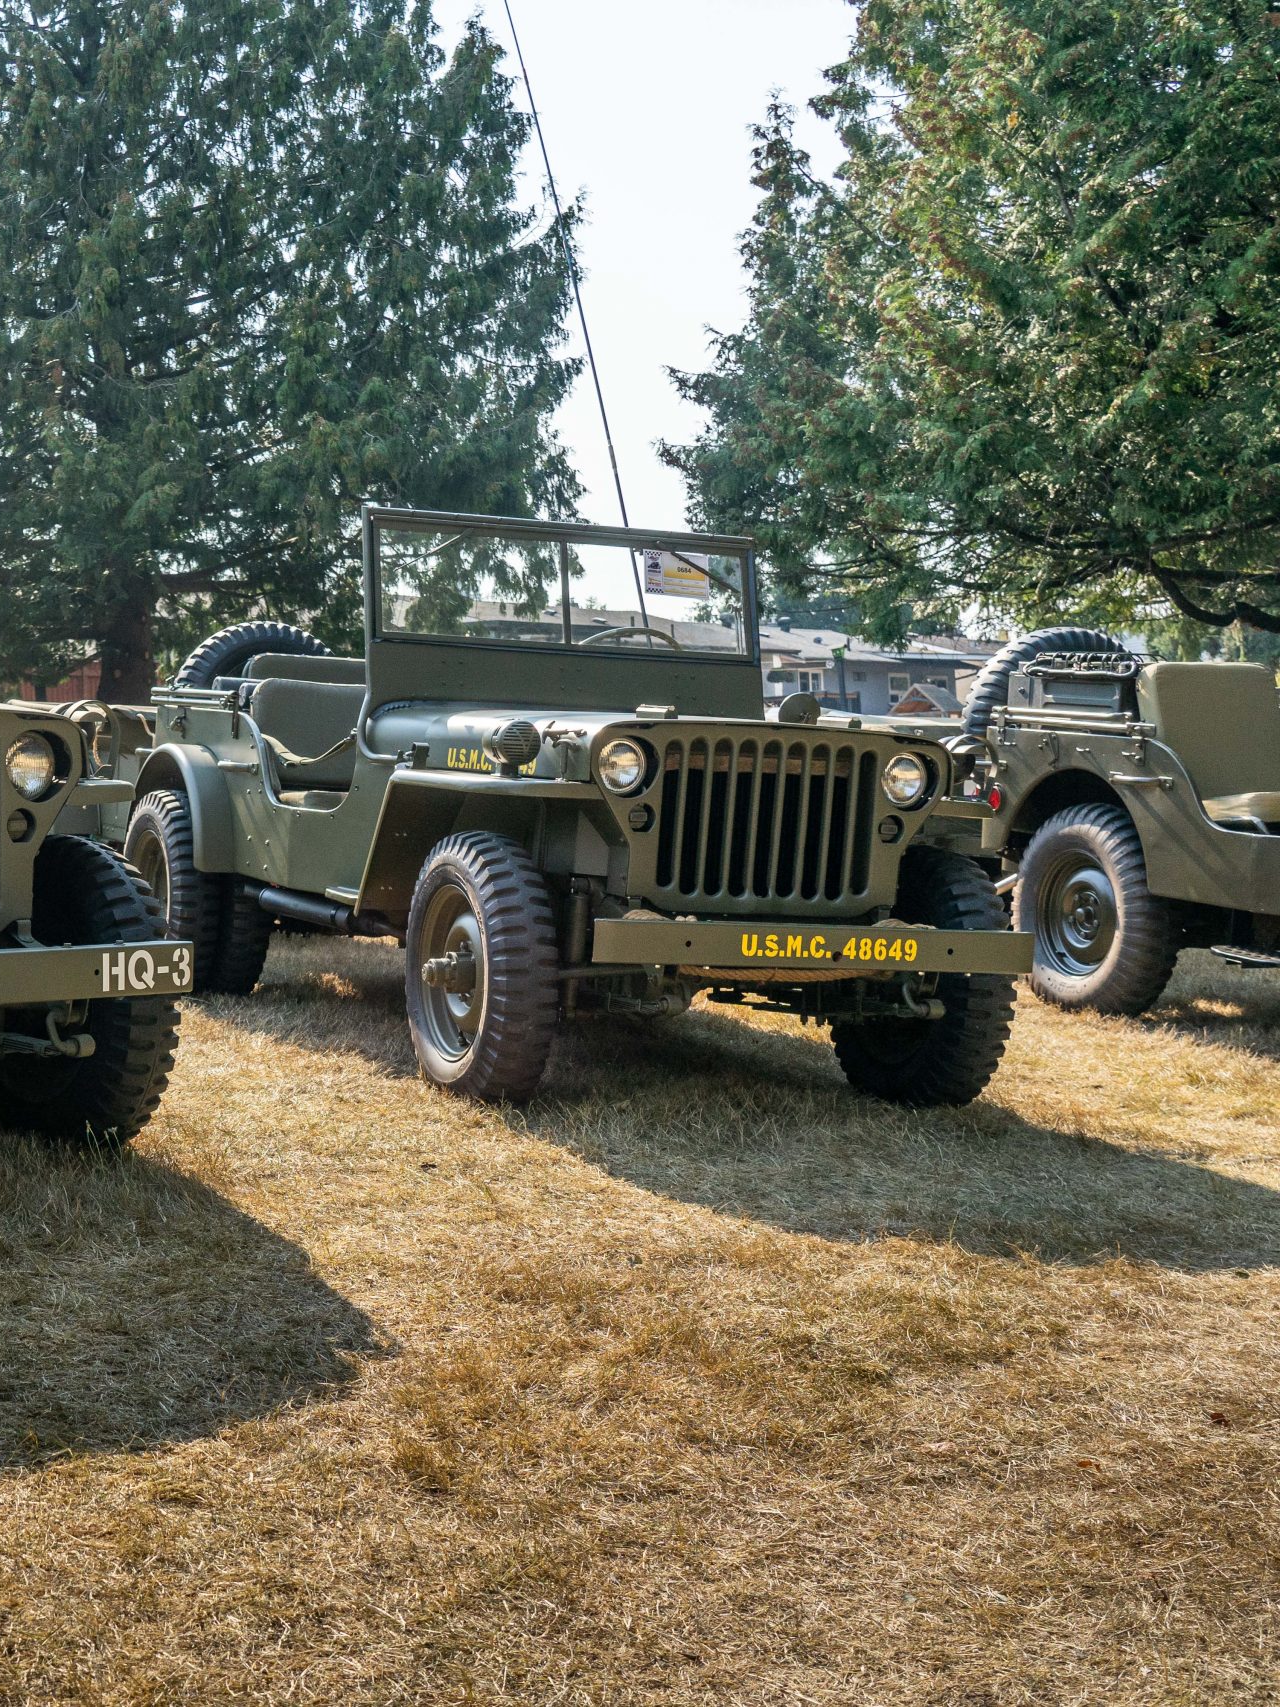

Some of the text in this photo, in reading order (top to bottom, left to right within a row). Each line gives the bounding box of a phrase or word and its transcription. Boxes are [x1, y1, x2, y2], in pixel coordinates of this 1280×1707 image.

[741, 934, 918, 962] U.S.M.C. 48649
[102, 947, 191, 992] HQ-3
